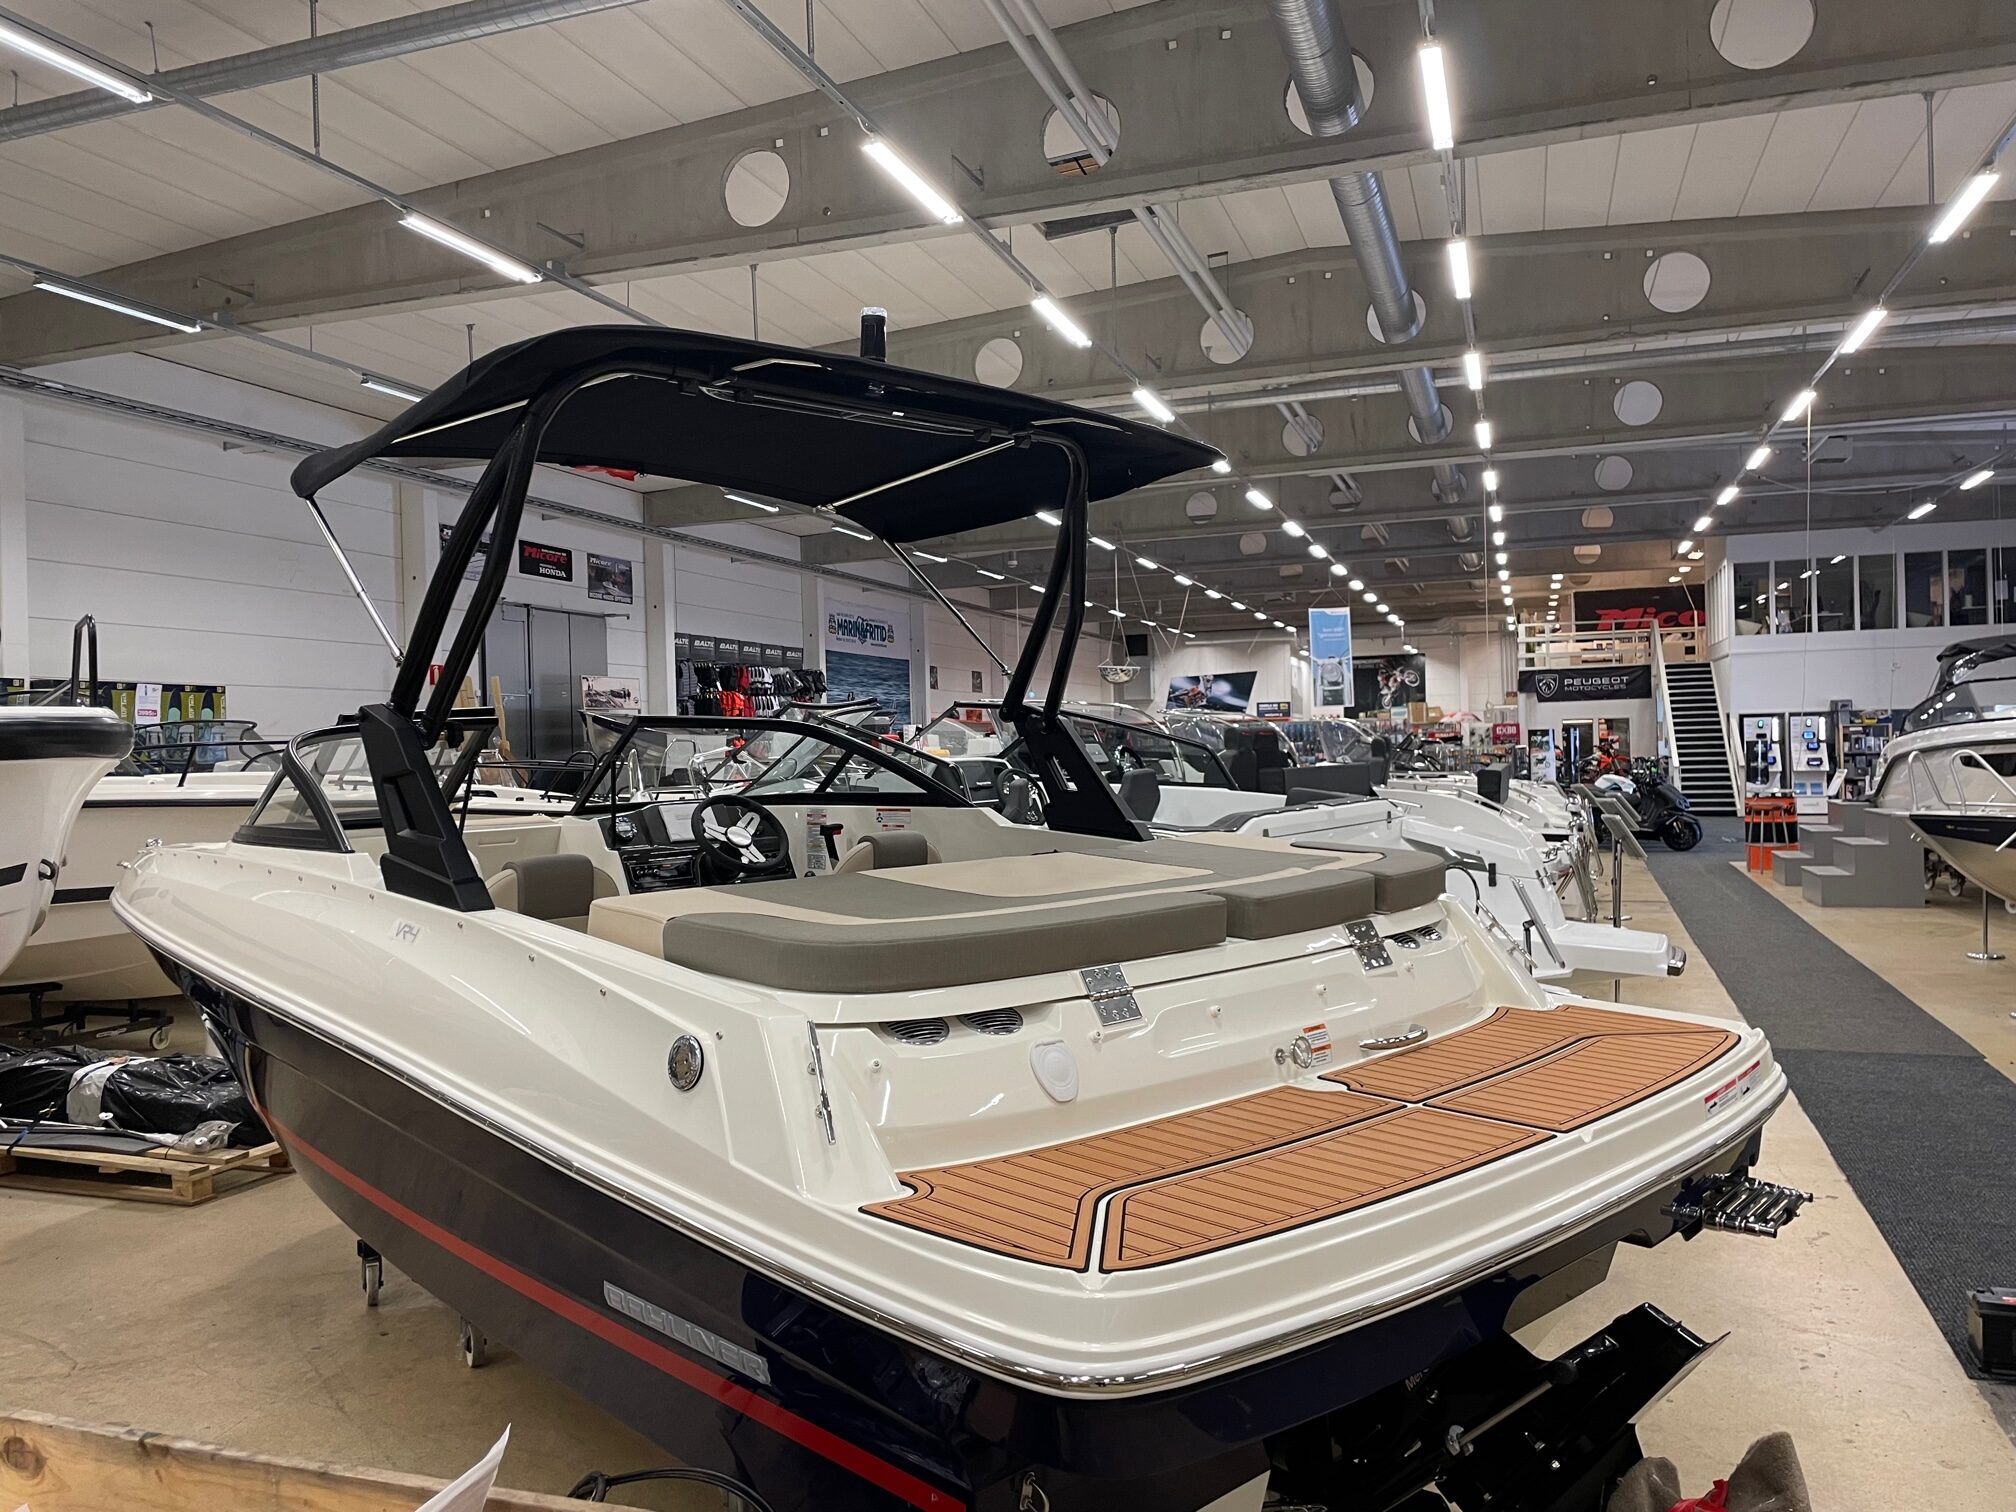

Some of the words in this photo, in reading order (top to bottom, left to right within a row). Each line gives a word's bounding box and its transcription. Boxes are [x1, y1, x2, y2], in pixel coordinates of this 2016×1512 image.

[524, 545, 568, 564] Micore
[539, 567, 567, 578] HONDA
[1564, 676, 1630, 686] PEUGEOT
[1564, 684, 1627, 692] MOTOCYCLES
